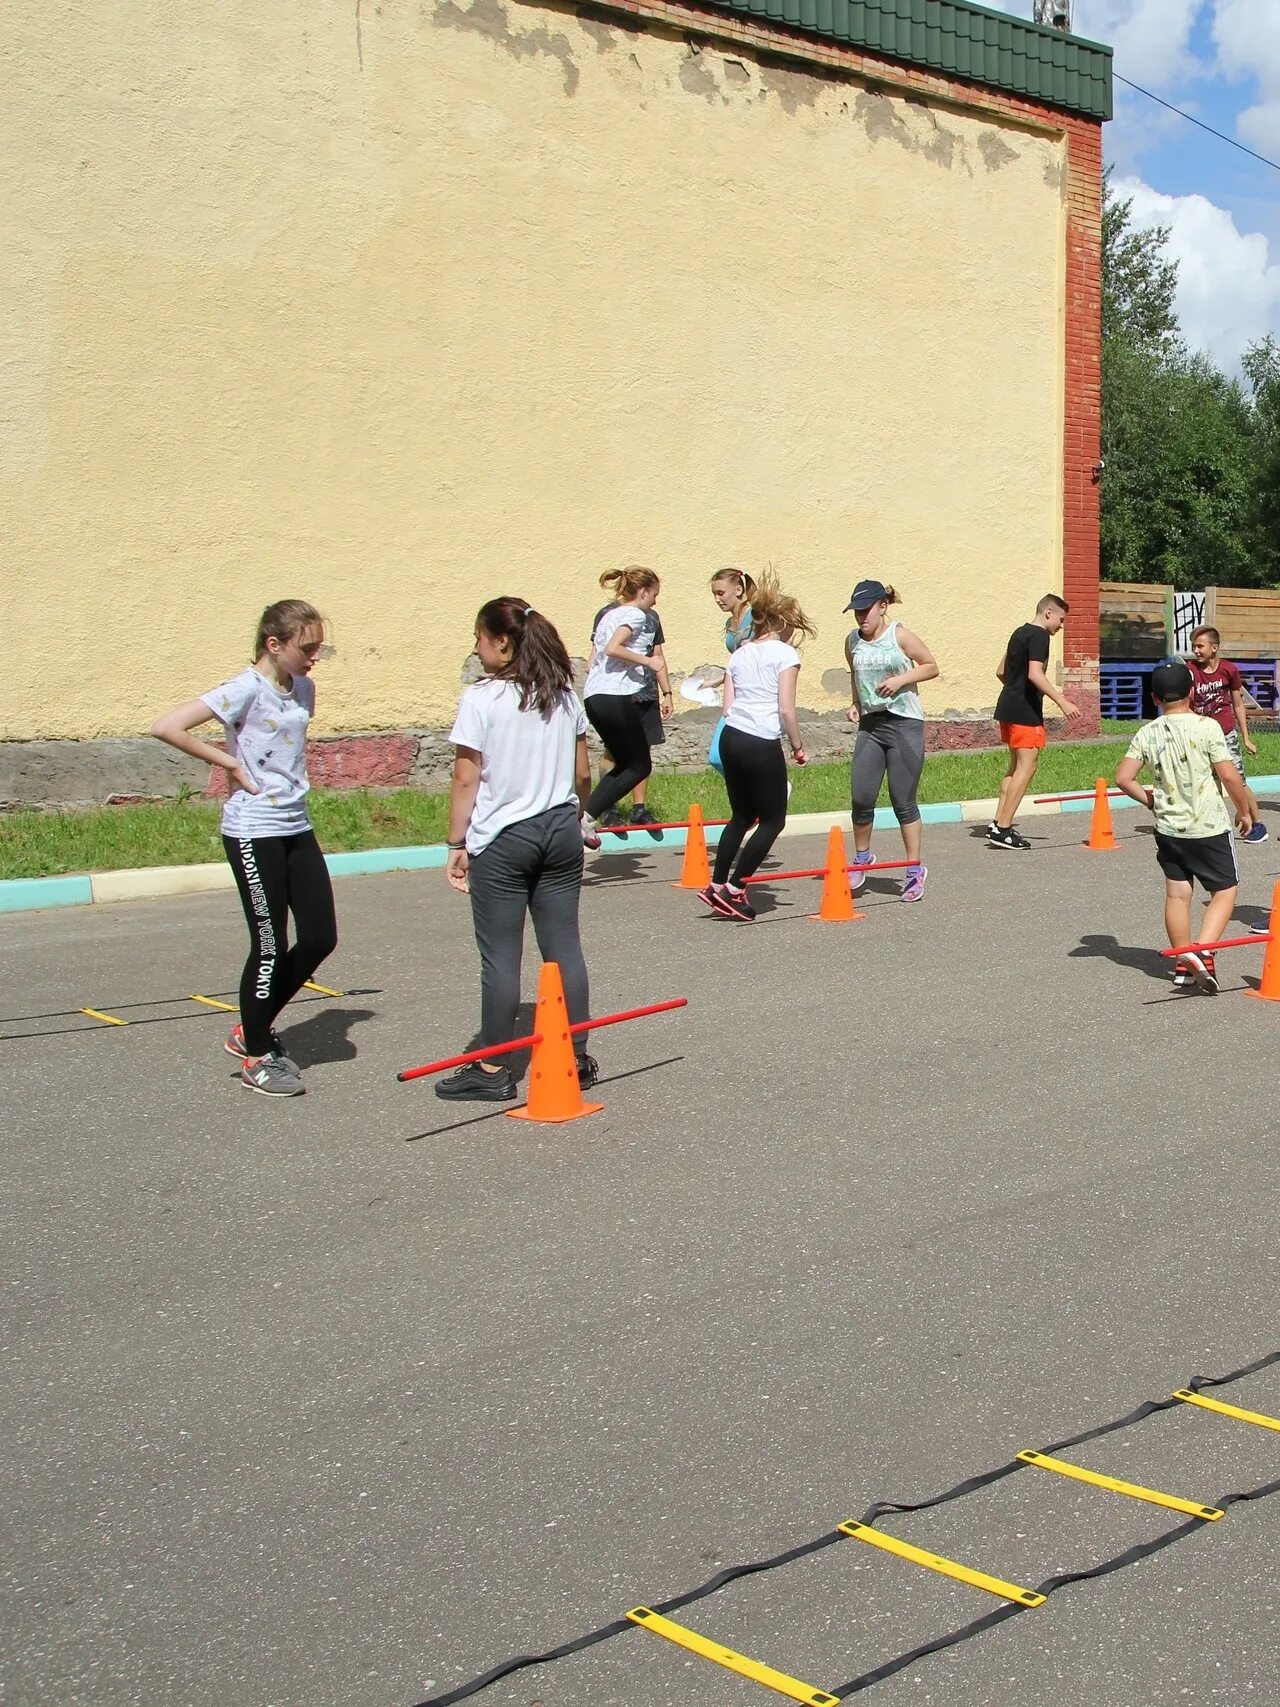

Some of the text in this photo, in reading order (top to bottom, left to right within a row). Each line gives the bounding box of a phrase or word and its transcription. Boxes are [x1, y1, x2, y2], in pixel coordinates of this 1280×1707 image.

[249, 883, 270, 917] NEW
[257, 918, 277, 956] YORK
[255, 958, 276, 999] TOKYO
